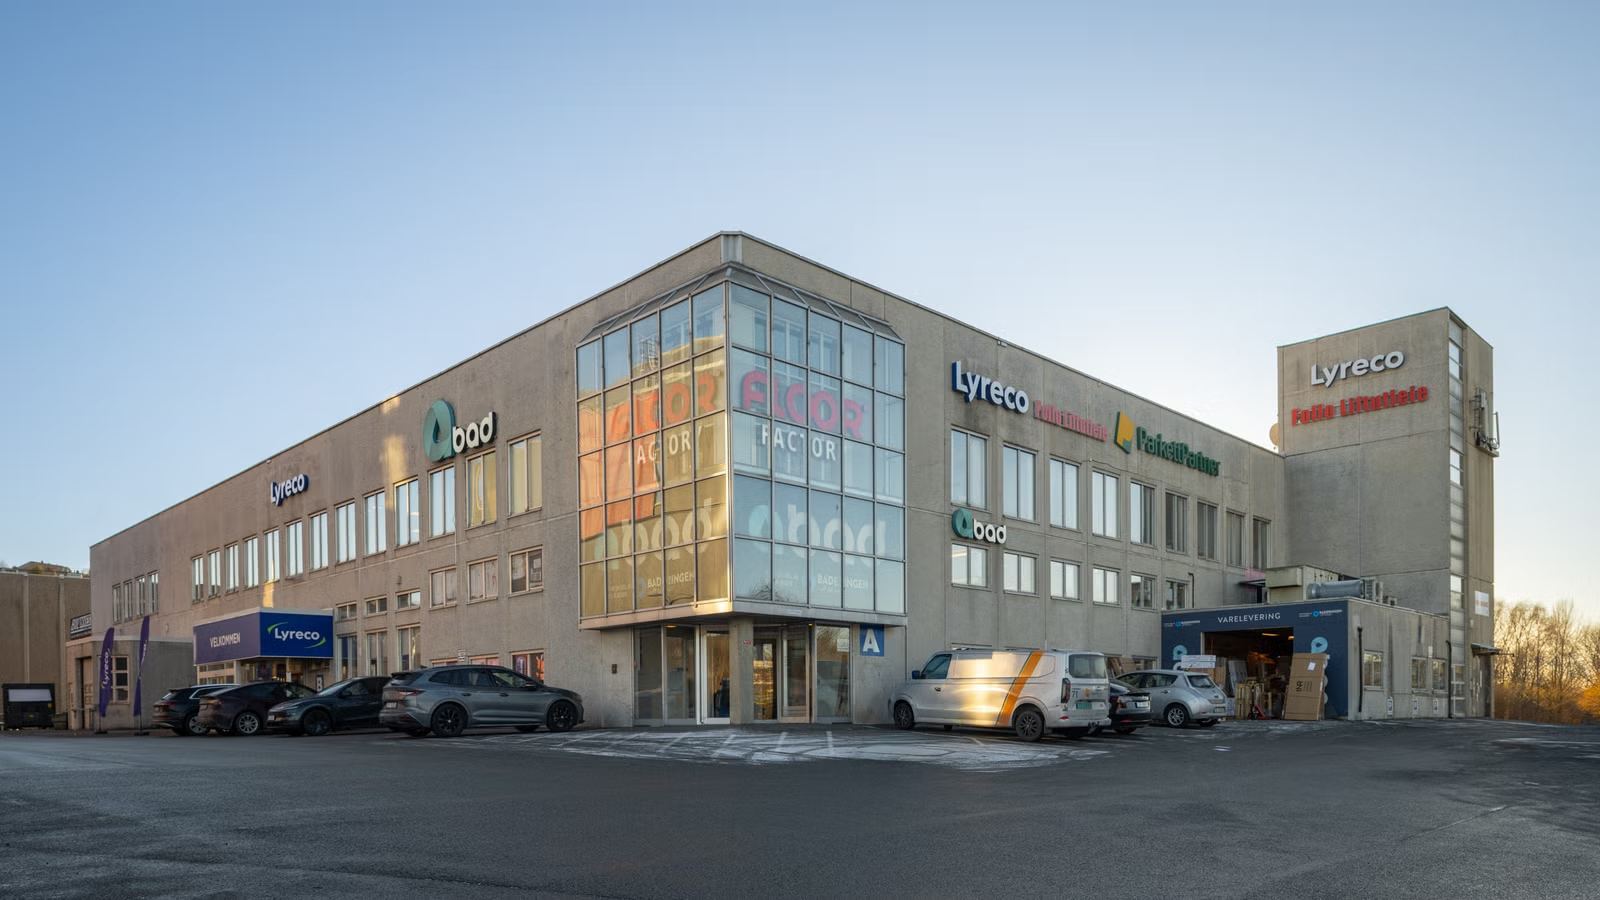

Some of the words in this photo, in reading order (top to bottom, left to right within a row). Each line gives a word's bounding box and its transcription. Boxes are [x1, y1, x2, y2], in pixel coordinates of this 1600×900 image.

[1311, 350, 1405, 388] Lyreco
[952, 360, 1029, 415] Lyreco
[1136, 426, 1221, 477] ParkettPartner
[270, 473, 308, 506] Lyreco
[274, 627, 321, 642] Lyreco
[1217, 612, 1281, 624] VARELEVERING
[210, 632, 241, 648] VELKOMMEN
[862, 629, 881, 653] A
[102, 651, 110, 685] Lyreco
